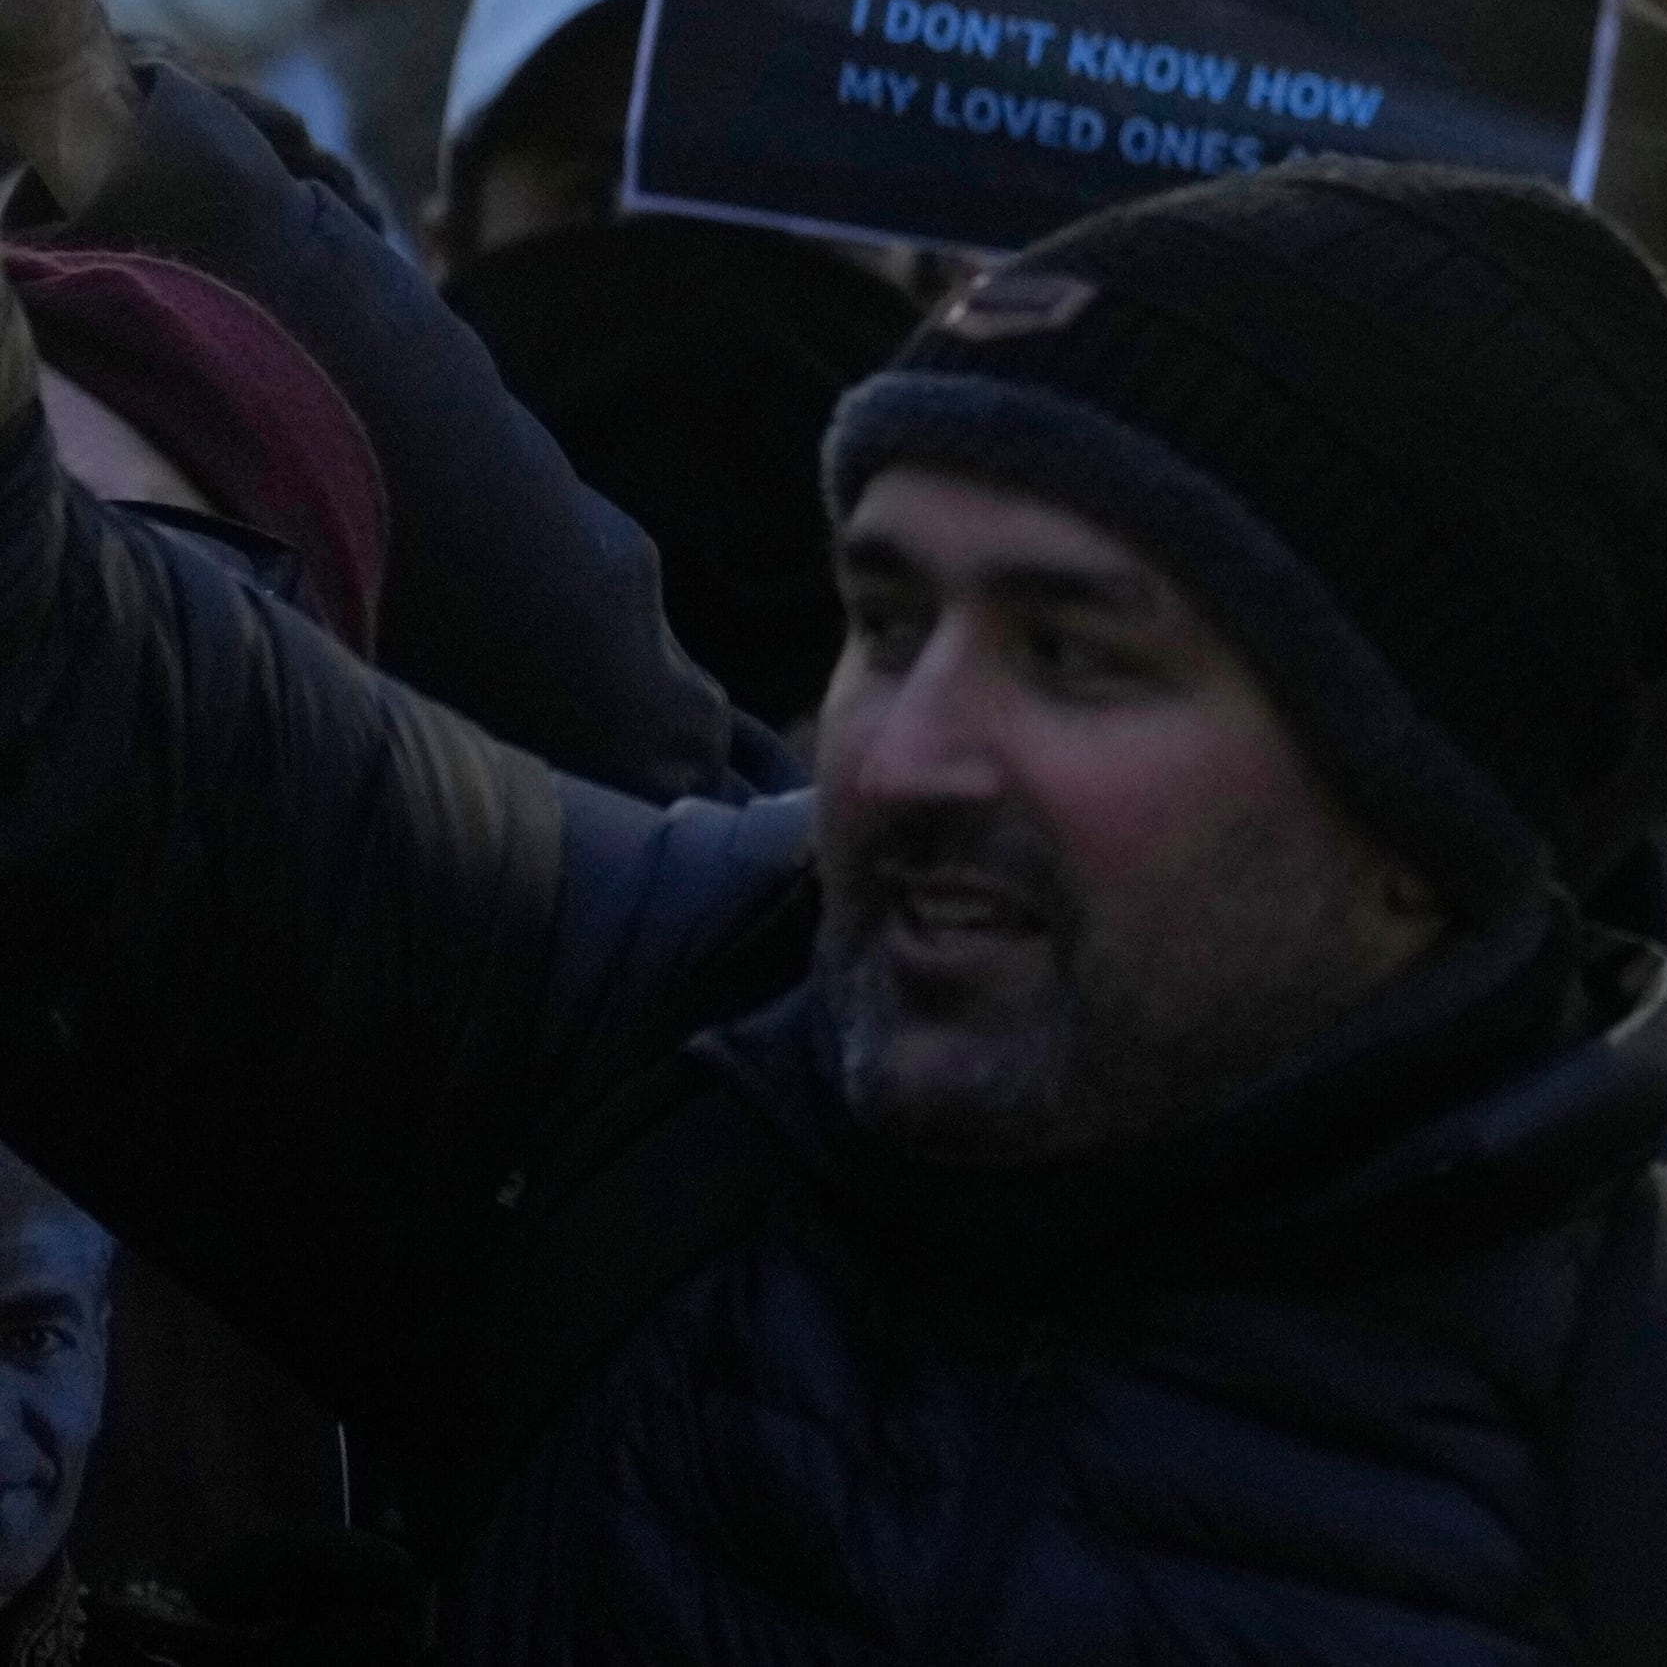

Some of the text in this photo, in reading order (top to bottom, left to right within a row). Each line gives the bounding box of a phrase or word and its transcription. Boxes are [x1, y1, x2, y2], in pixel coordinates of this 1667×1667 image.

[838, 60, 917, 112] MY
[933, 75, 1107, 152] LOVED
[1119, 110, 1262, 176] ONES
[1066, 31, 1238, 103] KNOW
[1246, 60, 1384, 129] HOW
